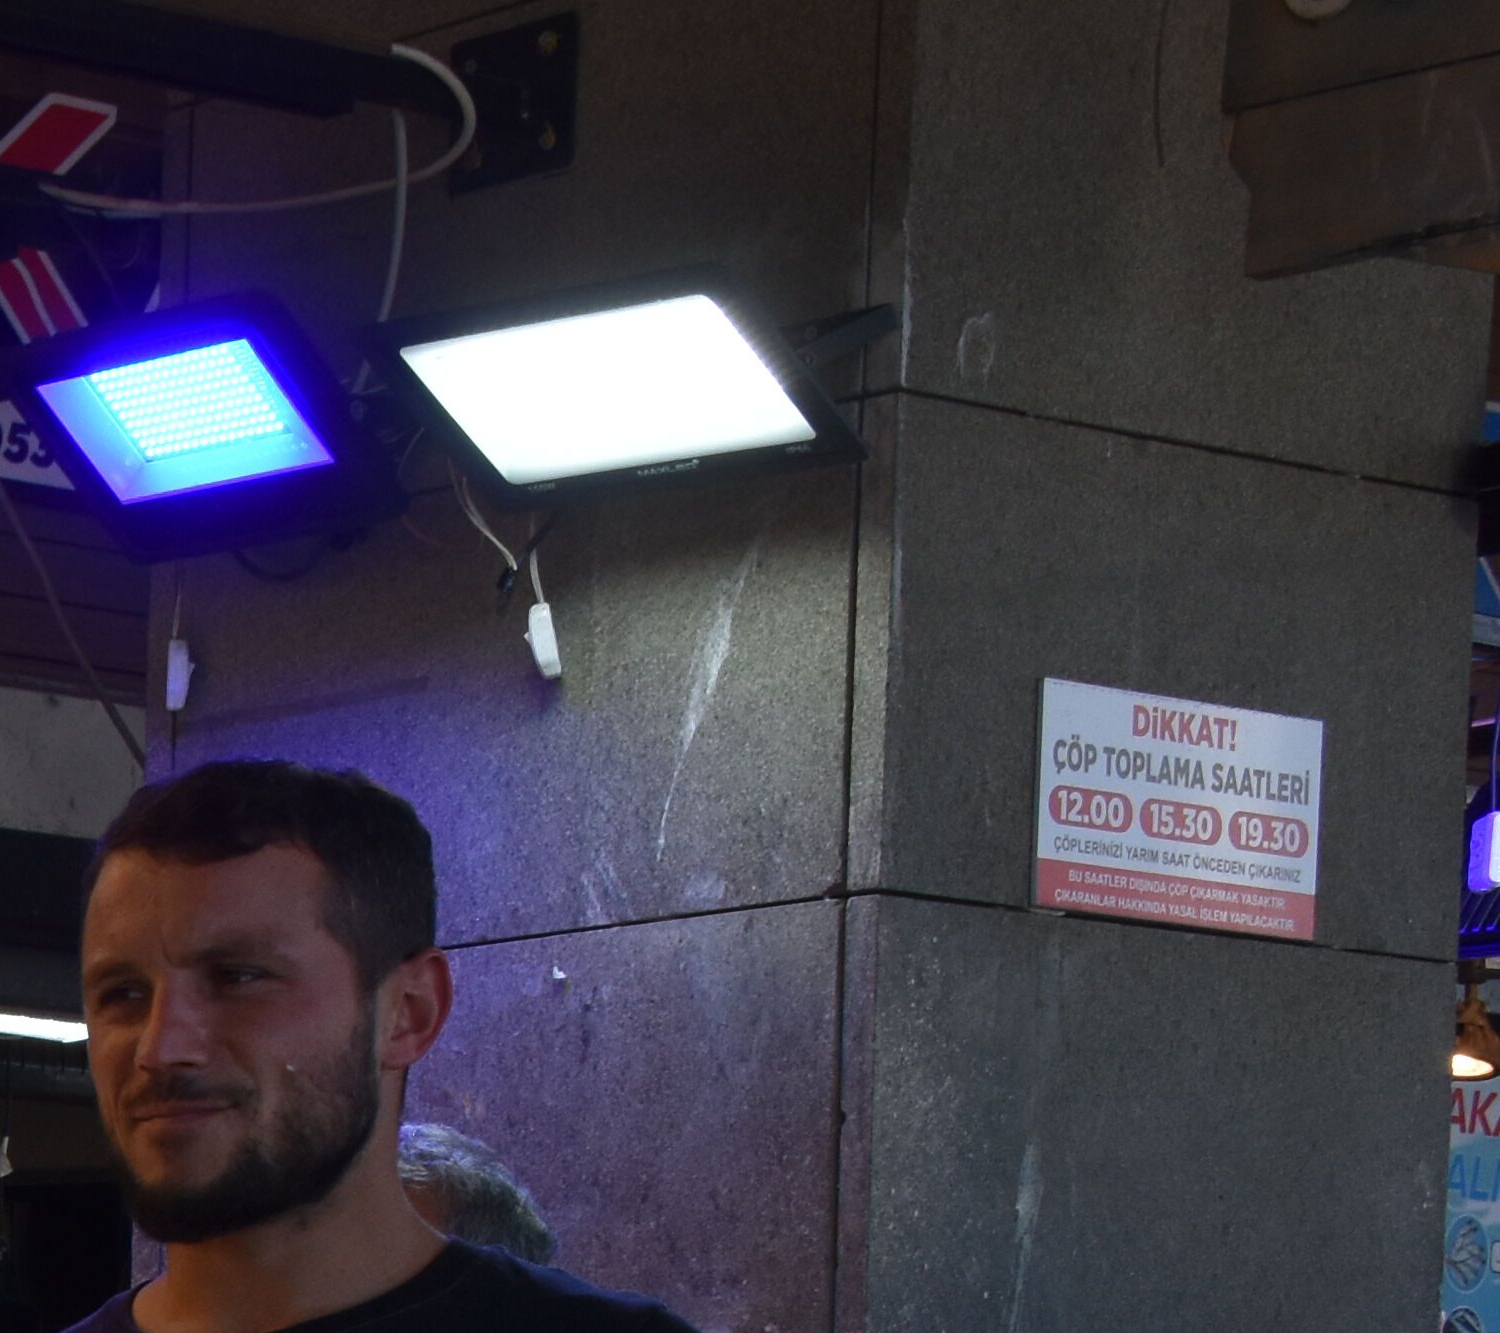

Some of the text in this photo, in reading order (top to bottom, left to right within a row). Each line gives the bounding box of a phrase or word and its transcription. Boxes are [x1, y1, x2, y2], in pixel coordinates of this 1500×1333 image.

[1052, 734, 1310, 806] ÇÖP TOPLAMA SAATLERİ
[1057, 790, 1300, 852] 12.00 15.30 19.30
[1125, 846, 1159, 864] YARIM
[1161, 852, 1191, 869] SAAT
[1192, 854, 1246, 876] ÖNCEDEN
[1068, 869, 1082, 882] BU
[1084, 871, 1128, 890] SAATLER
[1118, 897, 1167, 916] HAKKINDA
[1168, 903, 1198, 919] YASAL
